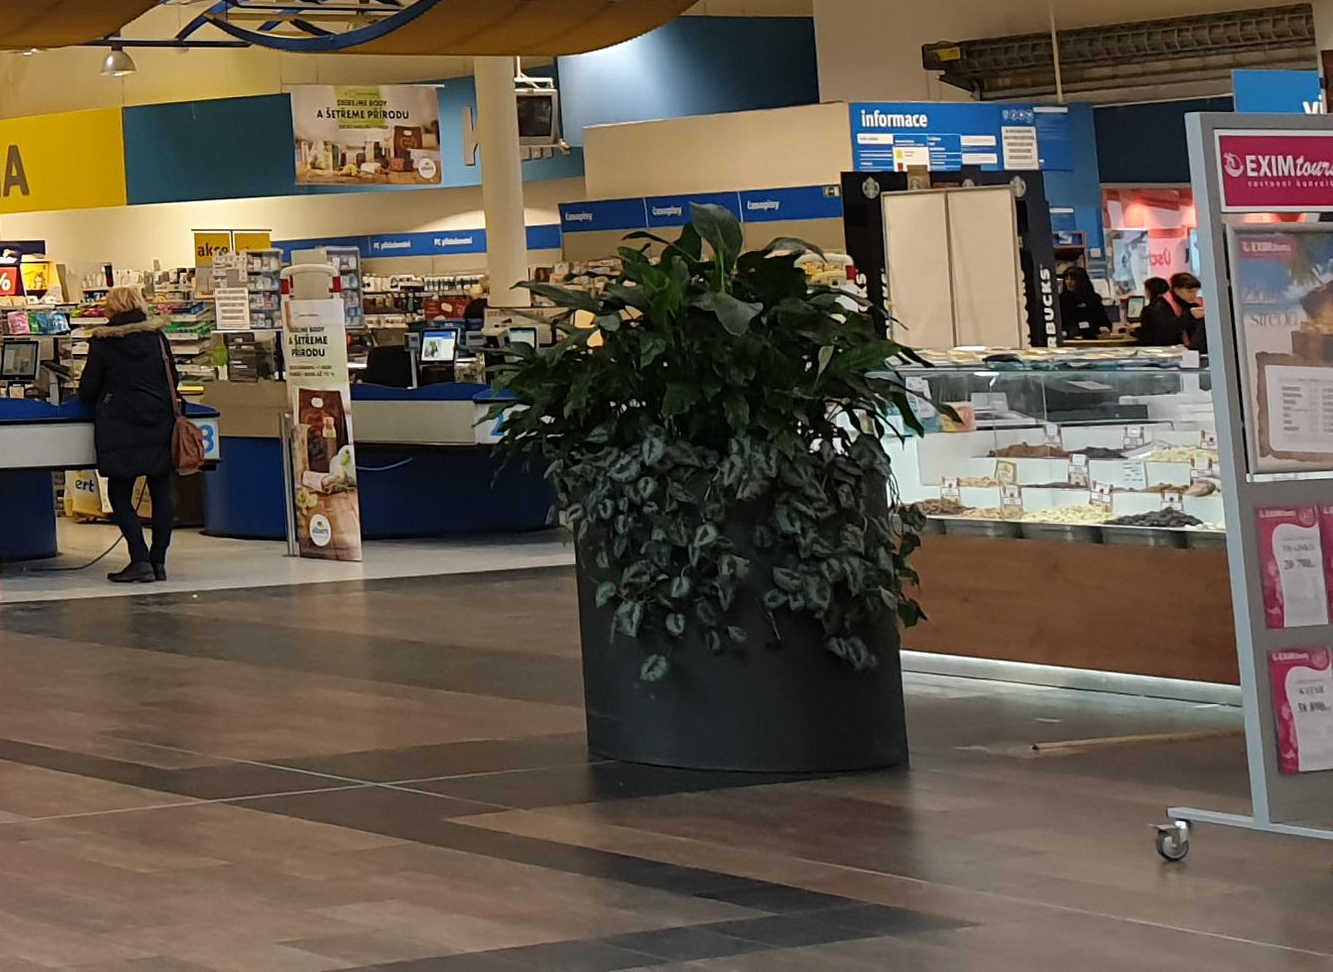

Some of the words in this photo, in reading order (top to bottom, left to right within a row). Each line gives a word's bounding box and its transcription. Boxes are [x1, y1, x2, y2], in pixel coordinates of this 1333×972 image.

[317, 109, 323, 118] A
[368, 108, 409, 119] PŘÍRODU
[860, 109, 928, 127] informace
